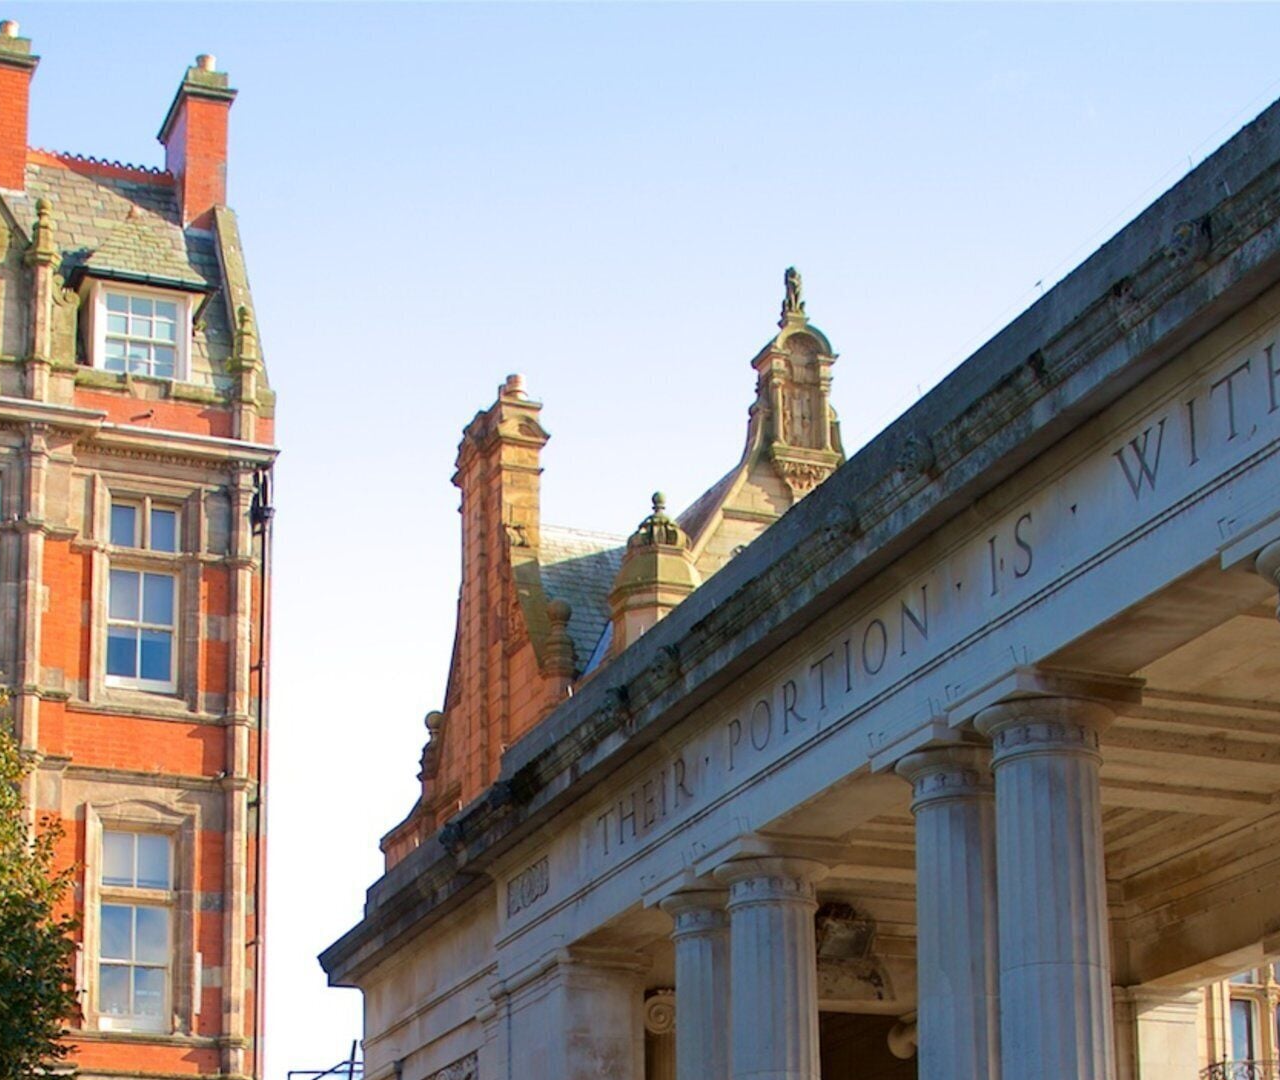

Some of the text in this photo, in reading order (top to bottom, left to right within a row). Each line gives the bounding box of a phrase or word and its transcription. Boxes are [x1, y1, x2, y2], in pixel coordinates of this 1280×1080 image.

[597, 760, 694, 855] THEIR
[727, 585, 930, 771] PORTION
[986, 512, 1033, 597] IS
